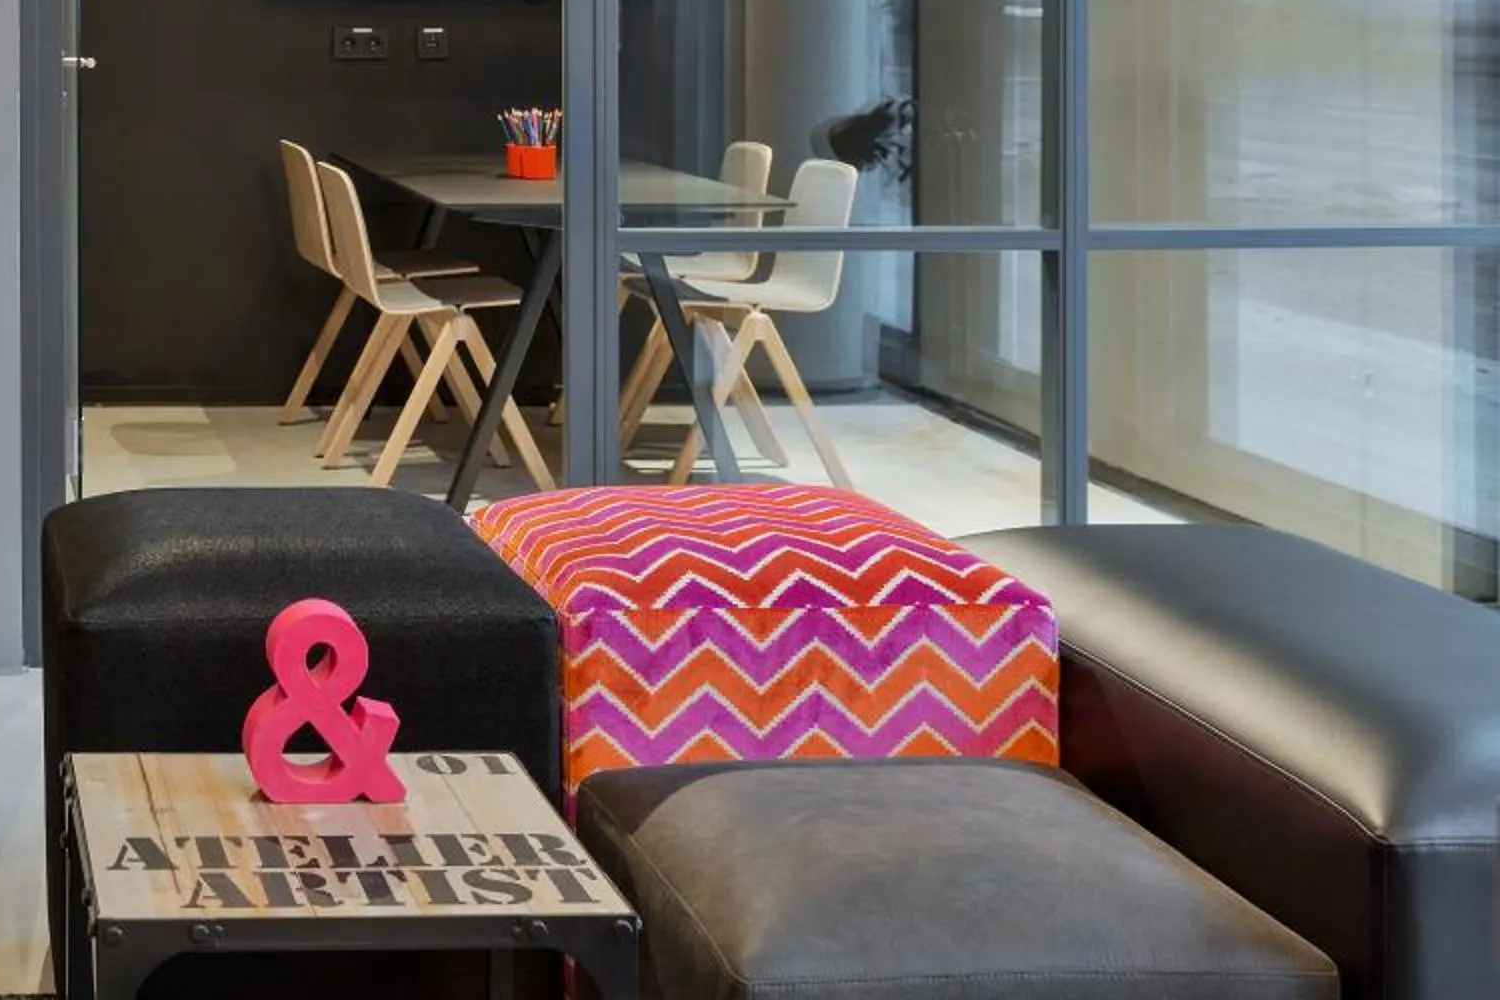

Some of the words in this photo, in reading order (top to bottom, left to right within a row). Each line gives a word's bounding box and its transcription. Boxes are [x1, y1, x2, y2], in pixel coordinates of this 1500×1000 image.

[242, 598, 407, 804] &
[106, 834, 587, 871] ATELIER
[180, 867, 602, 909] ARTIST
